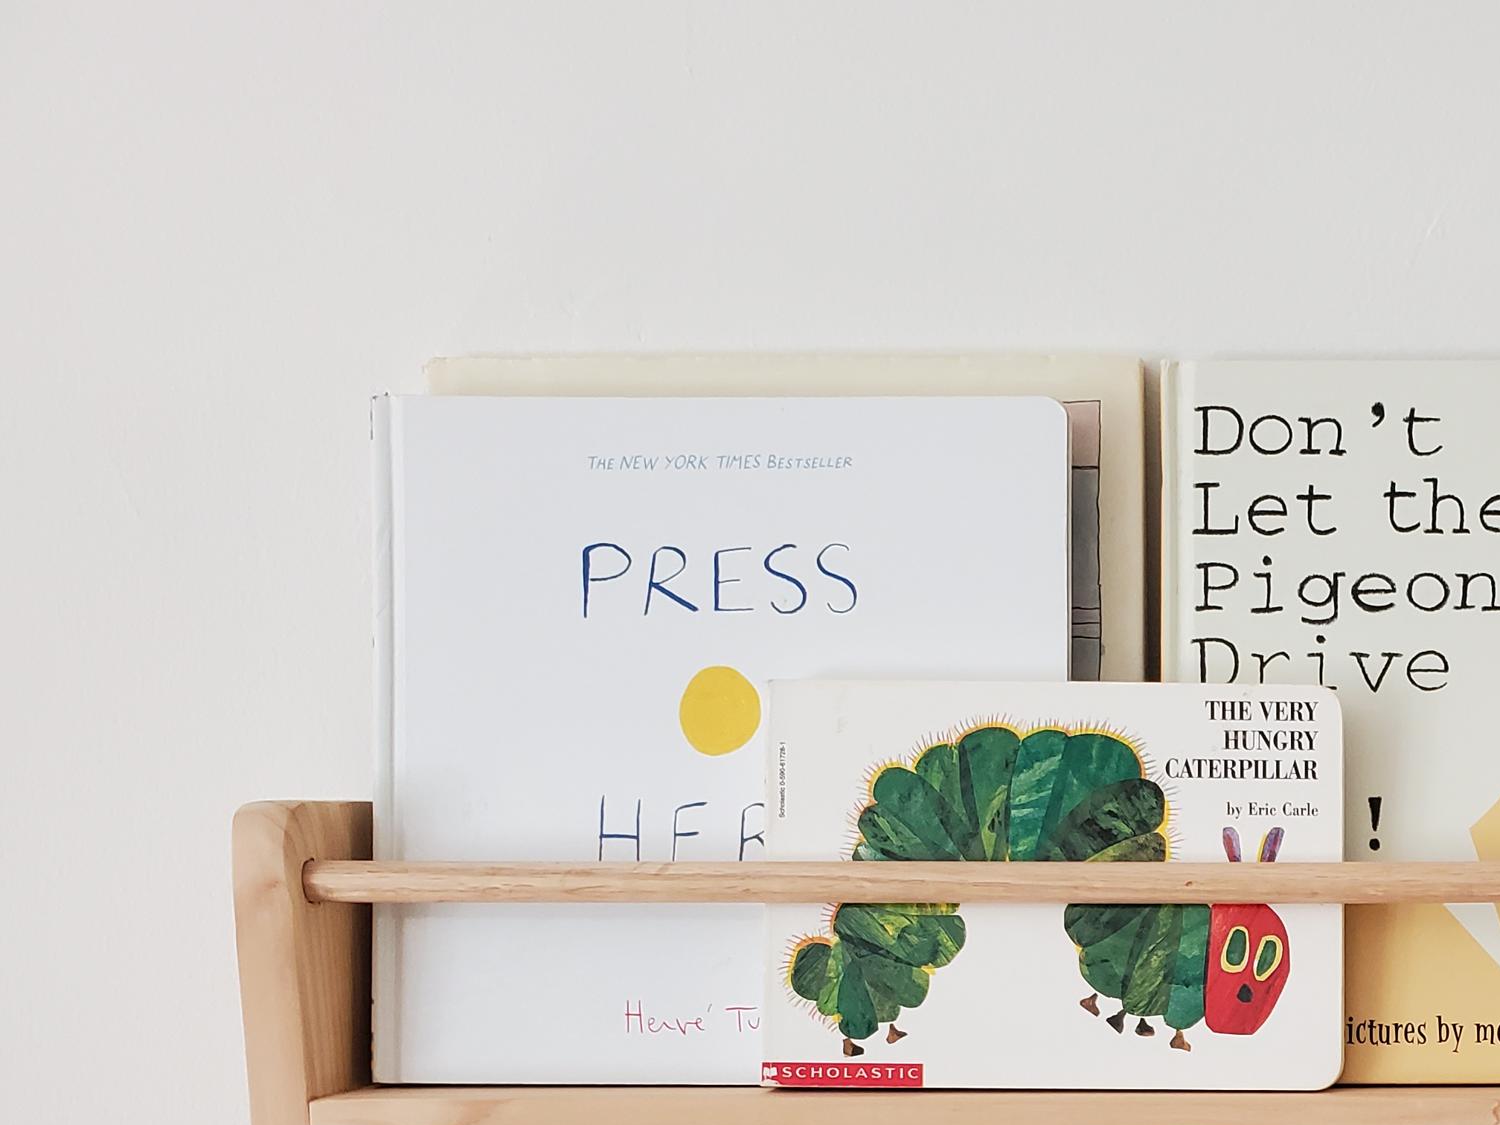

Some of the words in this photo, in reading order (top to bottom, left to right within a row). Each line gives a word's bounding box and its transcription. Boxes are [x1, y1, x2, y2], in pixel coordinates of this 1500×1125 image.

[1194, 402, 1443, 456] Don't
[587, 455, 615, 470] THE
[620, 455, 659, 471] NEW
[665, 454, 708, 470] YORK
[717, 454, 761, 469] TIMES
[767, 454, 852, 470] BESTSELLER
[1192, 482, 1337, 536] Let
[582, 542, 857, 618] PRESS
[1191, 635, 1449, 693] Drive
[1205, 700, 1252, 721] THE
[1259, 701, 1319, 722] VERY
[1222, 730, 1319, 751] HUNGRY
[1165, 757, 1319, 780] CATERPILLAR
[1226, 802, 1242, 819] by
[1249, 802, 1277, 816] Eric
[1282, 802, 1319, 817] Carle
[1345, 1016, 1428, 1045] ictures
[1436, 1015, 1464, 1053] by
[781, 1065, 919, 1080] SCHOLASTIC
